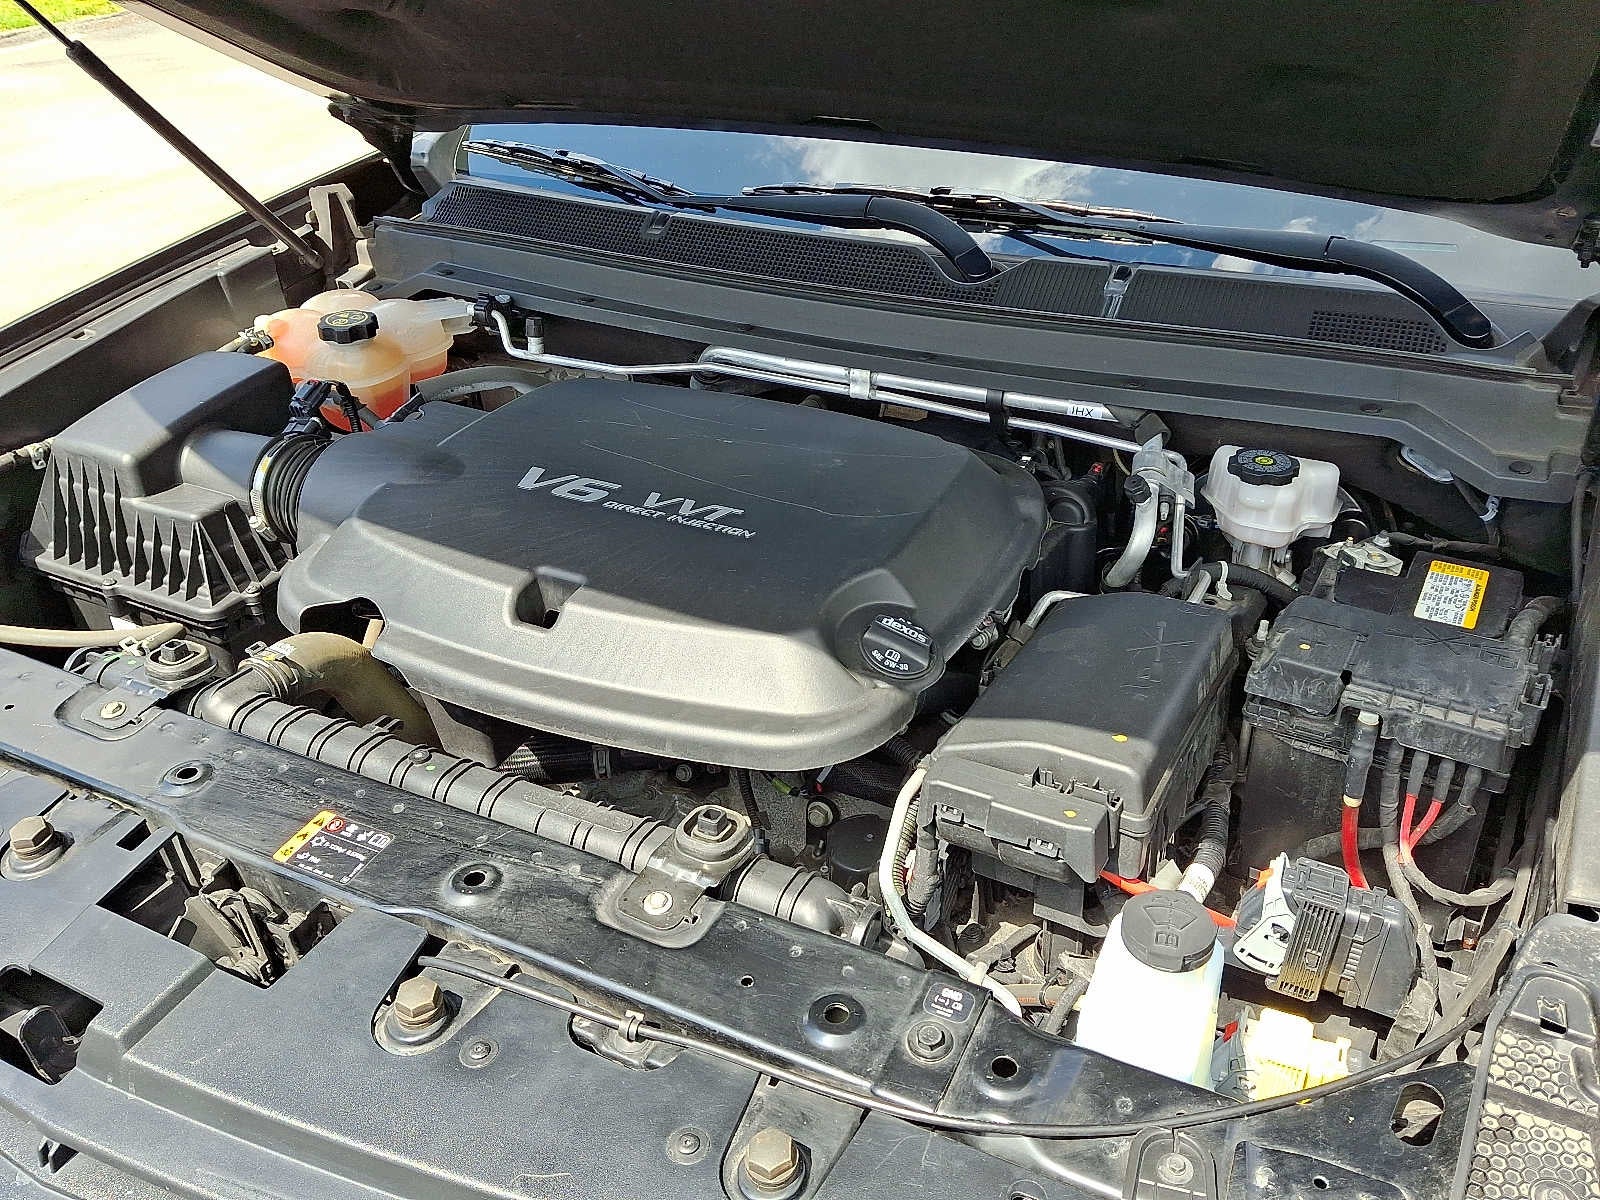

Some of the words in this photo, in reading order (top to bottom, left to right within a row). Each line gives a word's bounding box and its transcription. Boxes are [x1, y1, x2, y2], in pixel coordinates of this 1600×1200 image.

[517, 466, 622, 503] V6
[643, 491, 745, 522] VVT
[602, 500, 667, 519] DIRECT
[667, 513, 756, 539] INJECTION
[881, 617, 929, 643] dexos
[871, 649, 885, 662] SAE
[884, 659, 909, 671] 5W-30
